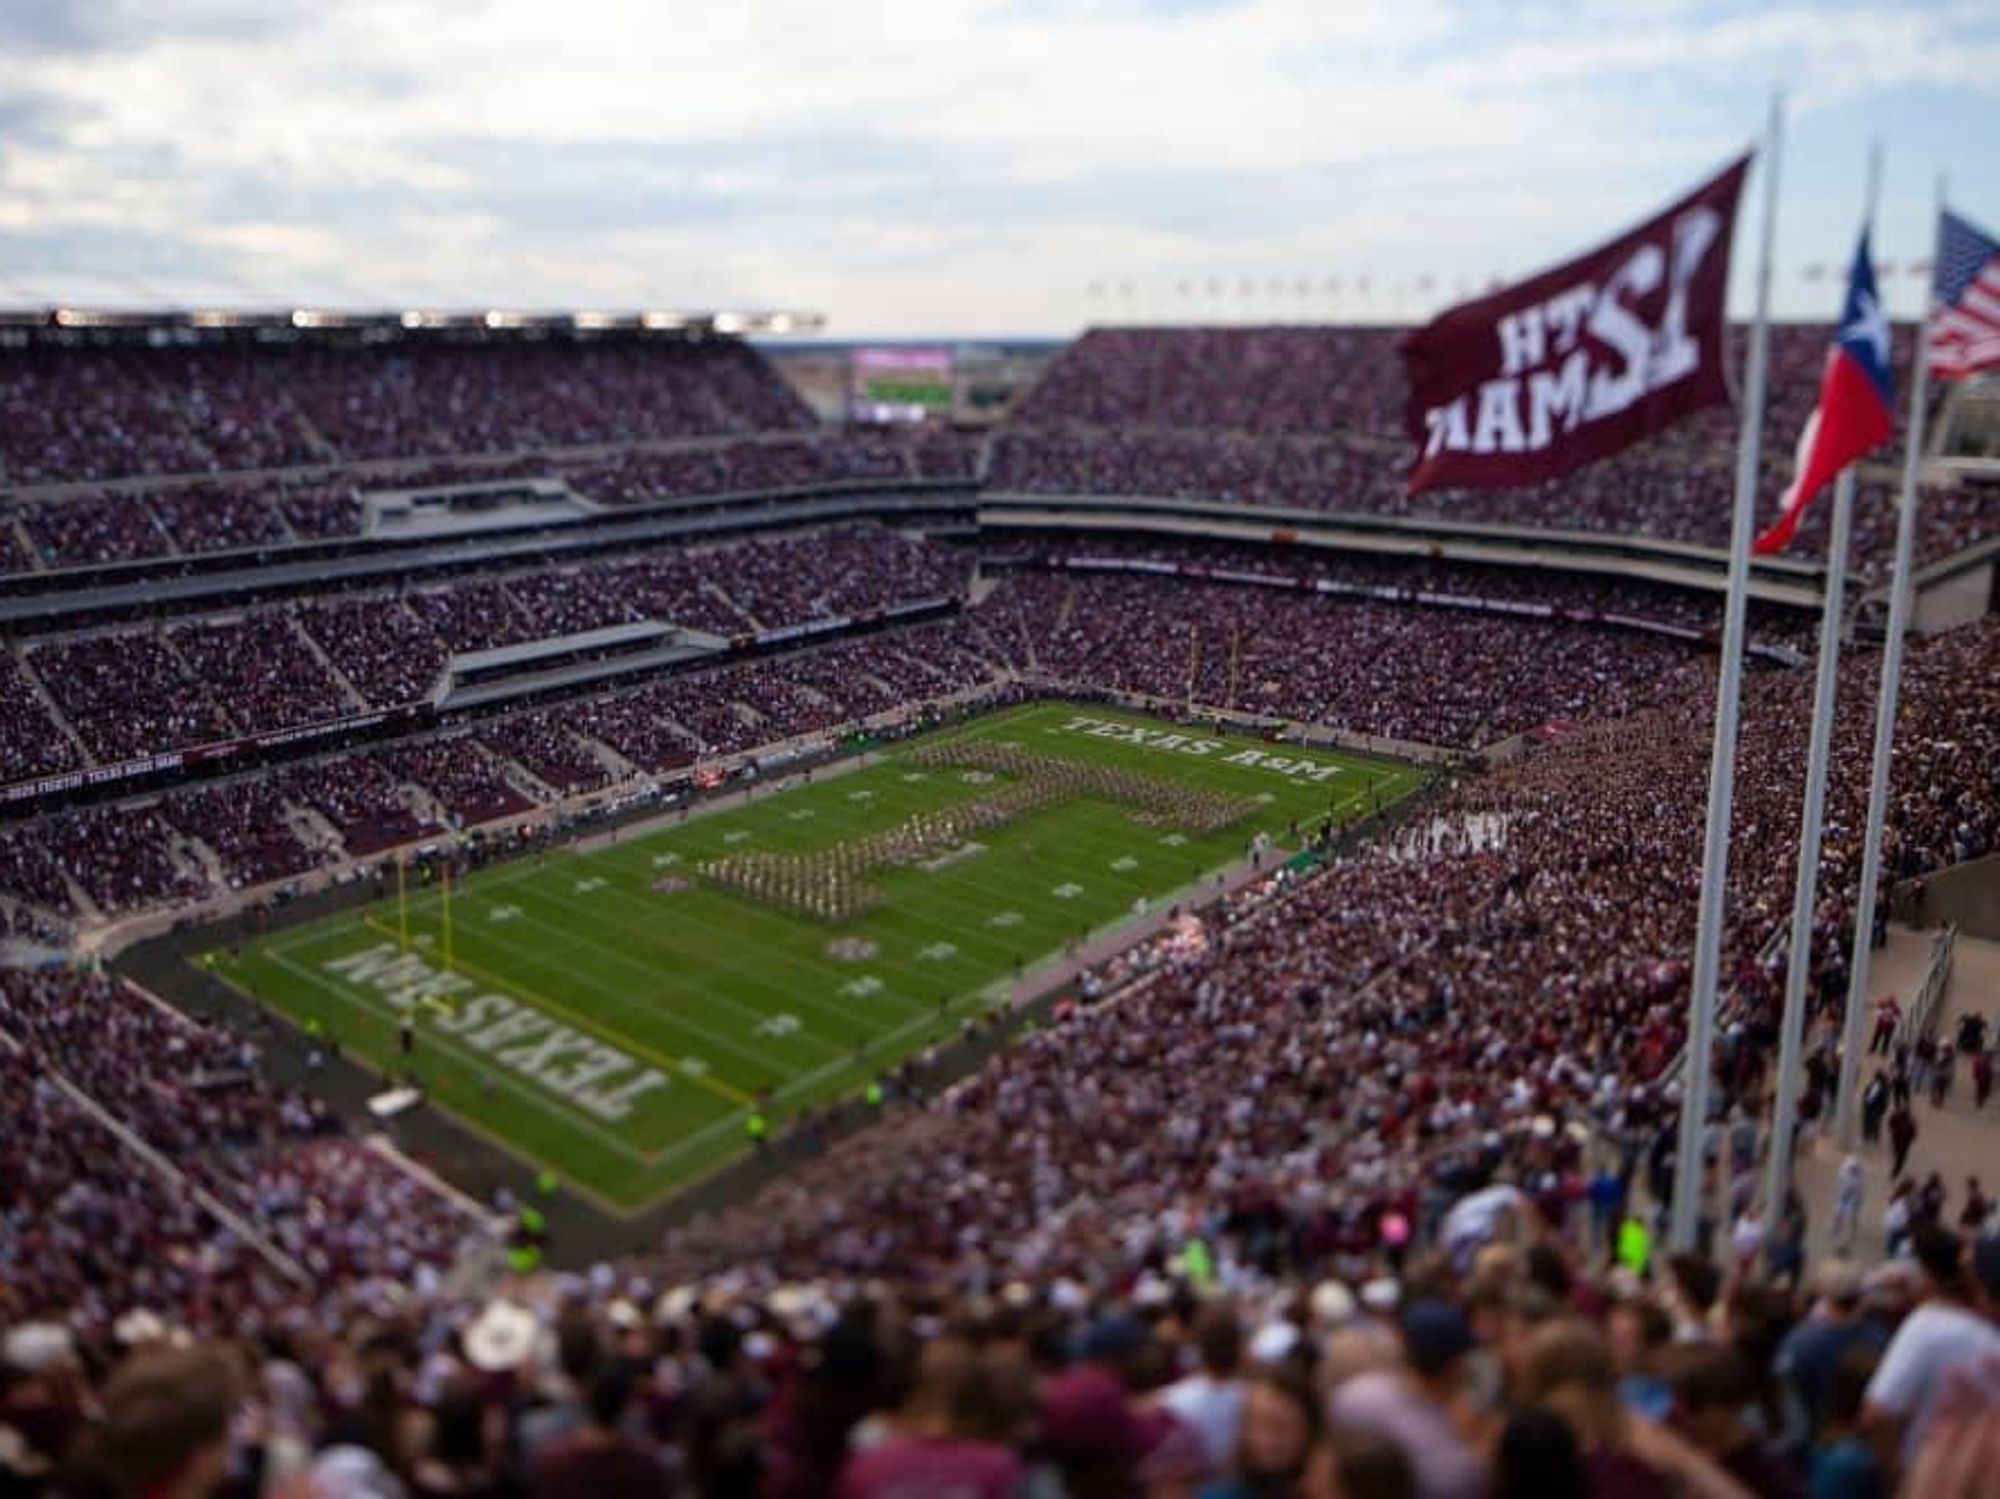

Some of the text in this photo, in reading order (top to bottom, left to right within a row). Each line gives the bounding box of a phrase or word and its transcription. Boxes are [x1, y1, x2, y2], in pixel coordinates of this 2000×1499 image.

[1061, 716, 1343, 782] TEXAS A&M
[321, 942, 672, 1122] TEXAS A&M
